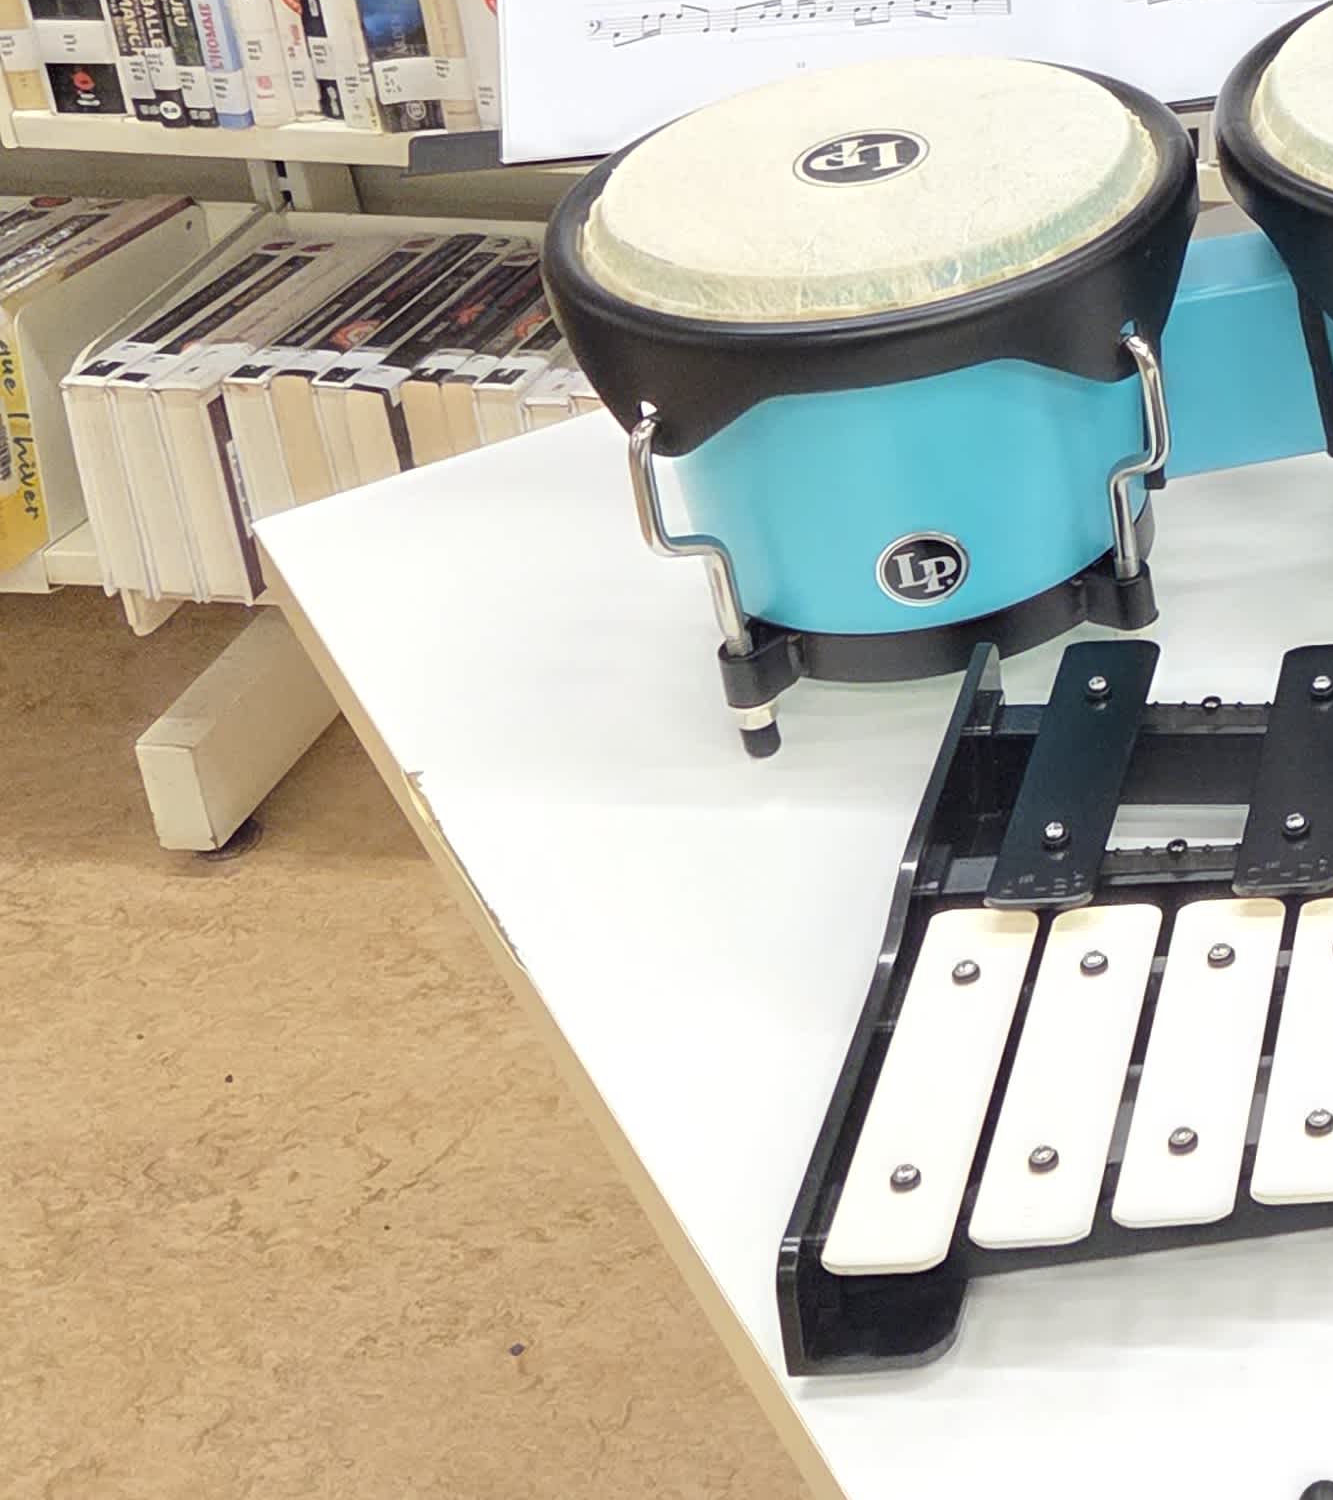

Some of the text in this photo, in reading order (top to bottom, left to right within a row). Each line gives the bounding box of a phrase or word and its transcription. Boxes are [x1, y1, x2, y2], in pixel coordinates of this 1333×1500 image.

[199, 3, 224, 70] L'HOMME
[809, 138, 904, 171] LP
[893, 553, 958, 594] LP
